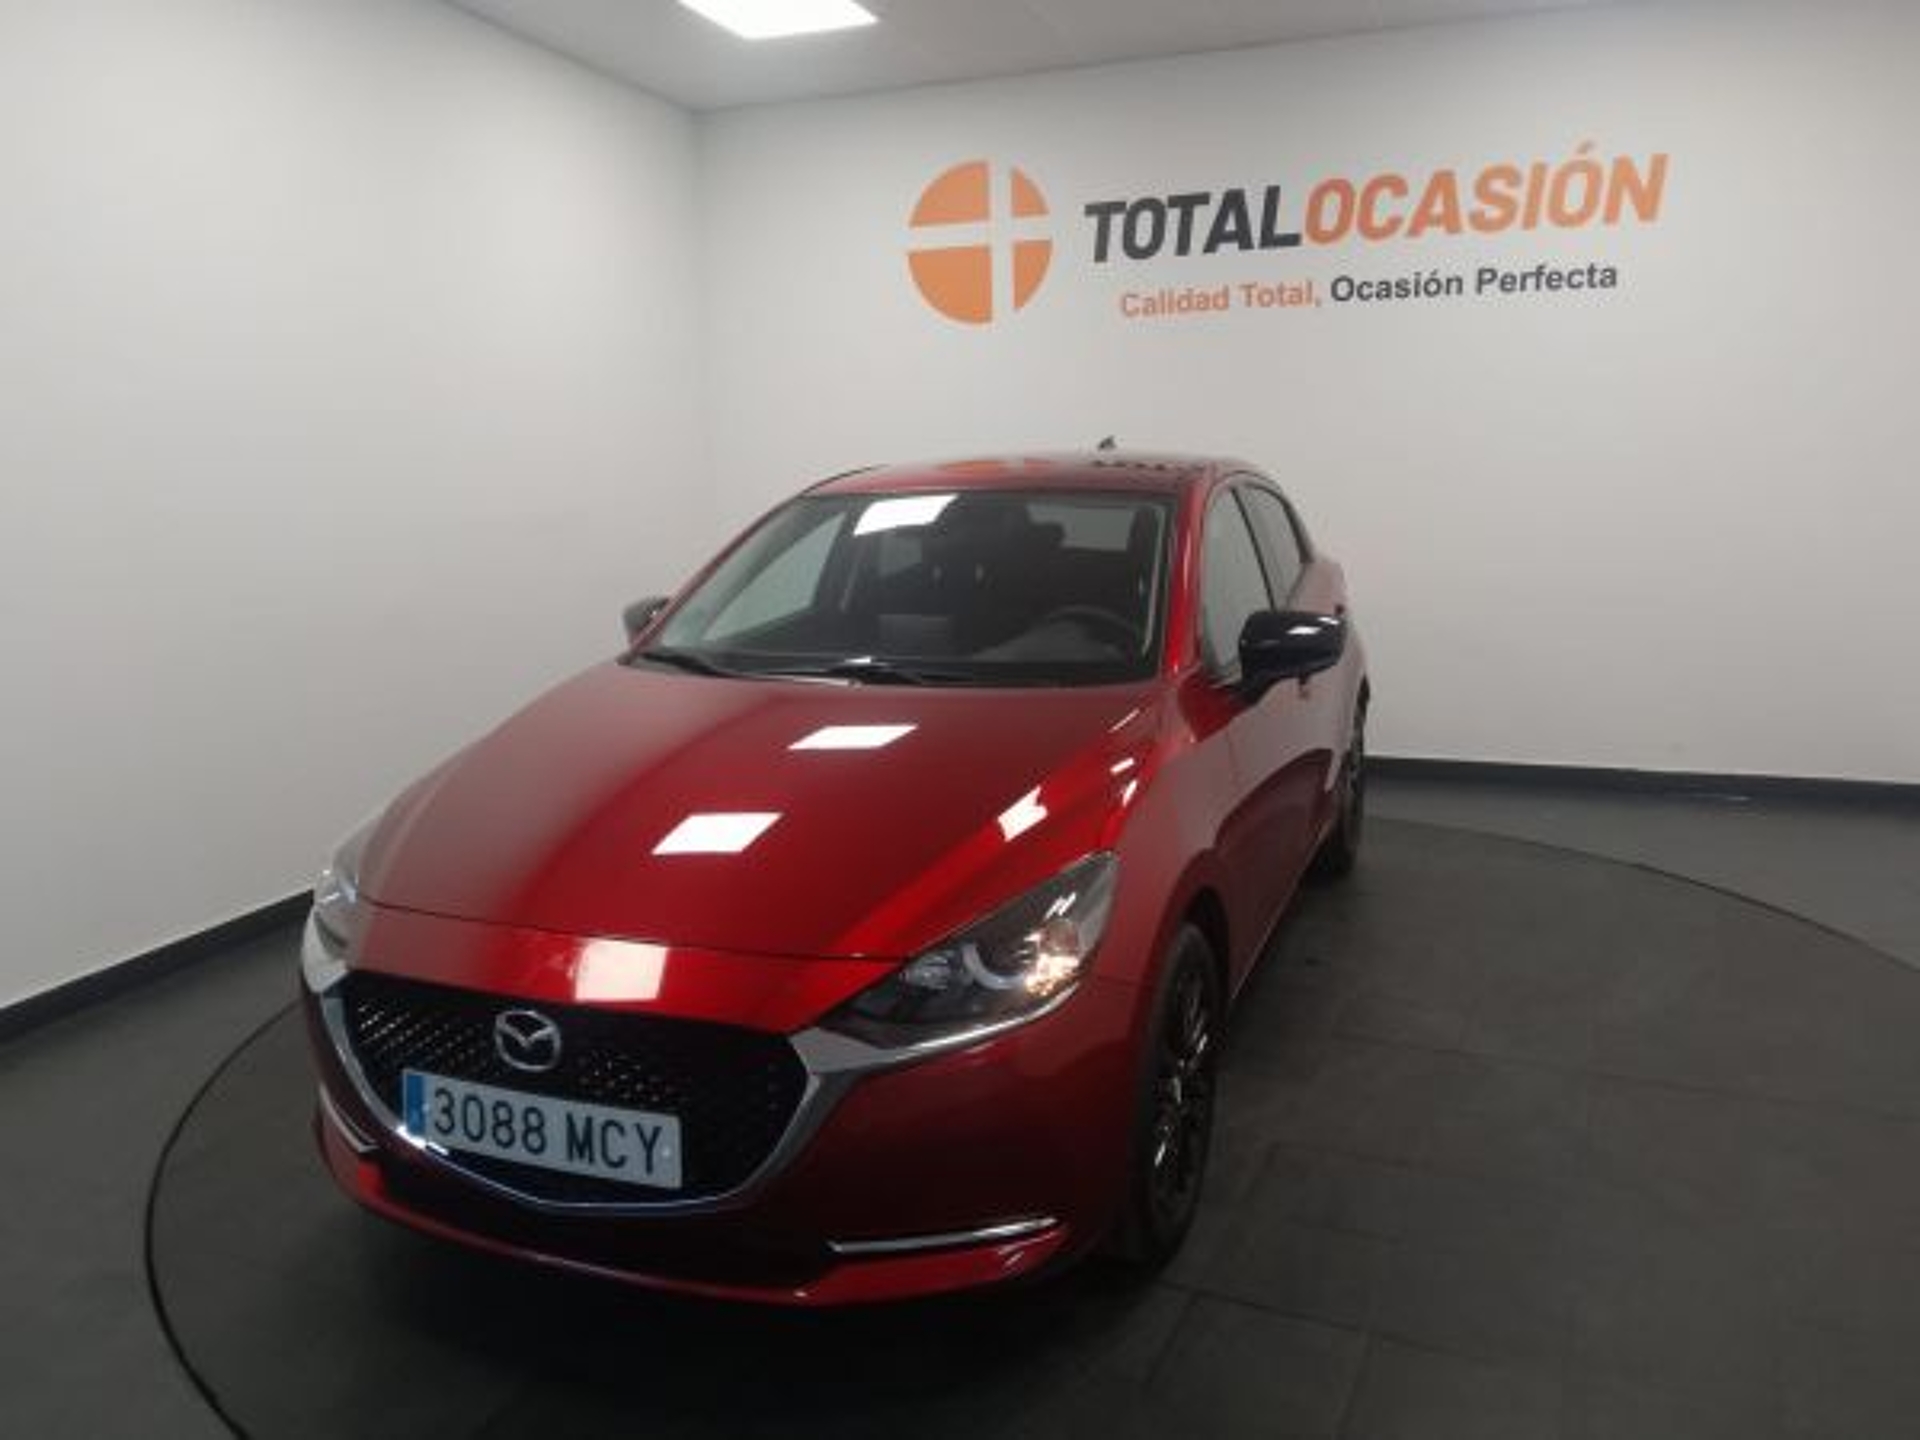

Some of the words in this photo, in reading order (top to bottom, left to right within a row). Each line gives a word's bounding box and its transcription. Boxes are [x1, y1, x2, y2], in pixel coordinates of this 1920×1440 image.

[1120, 286, 1230, 318] Calidad
[1239, 280, 1322, 310] Total,
[1330, 270, 1464, 302] Ocasión
[1475, 263, 1618, 295] Perfecta
[434, 1088, 547, 1155] 3088
[565, 1112, 662, 1175] MCY
